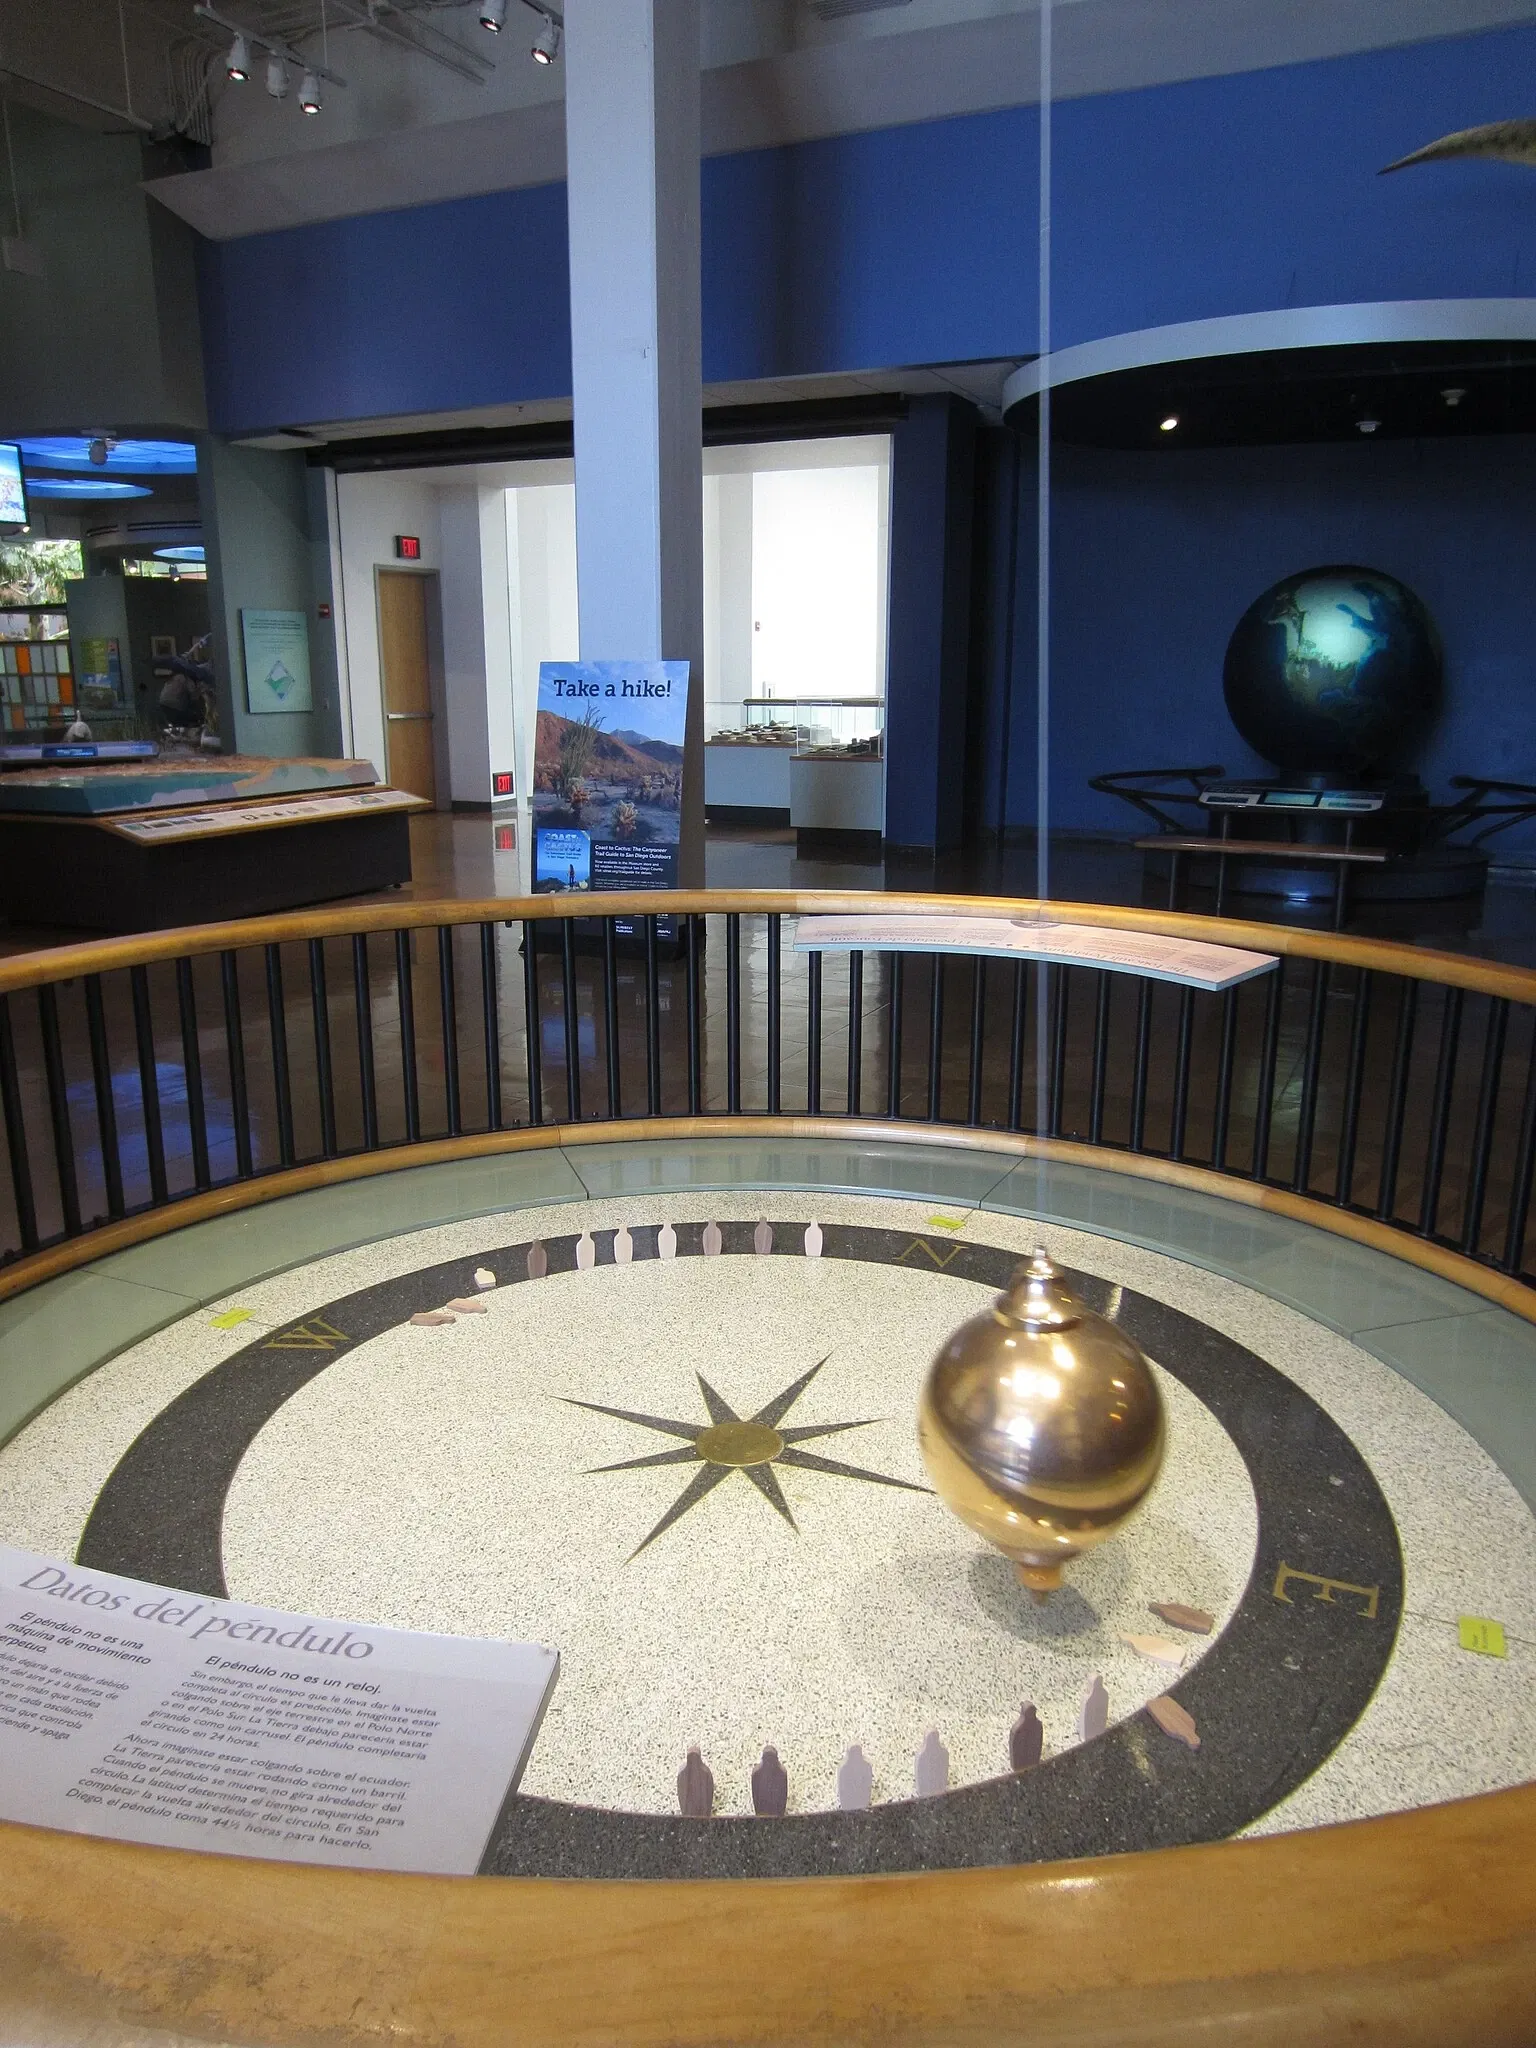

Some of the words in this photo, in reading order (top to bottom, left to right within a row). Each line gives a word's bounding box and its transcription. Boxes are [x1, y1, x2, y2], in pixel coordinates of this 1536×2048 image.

[402, 539, 417, 556] EXIT
[553, 679, 600, 697] Take
[605, 684, 616, 697] a
[621, 679, 671, 698] hike!
[892, 1239, 969, 1268] N
[261, 1315, 350, 1350] W
[1273, 1559, 1379, 1619] E
[19, 1566, 131, 1611] Datos
[133, 1598, 204, 1628] del
[189, 1615, 374, 1660] péndulo
[20, 1611, 36, 1621] El
[30, 1617, 82, 1635] péndulo
[83, 1631, 101, 1640] no
[103, 1635, 119, 1644] es
[120, 1639, 144, 1650] una
[5, 1622, 55, 1642] máquina
[57, 1636, 74, 1647] de
[75, 1641, 152, 1665] movimiento
[26, 1673, 45, 1682] aire
[72, 1684, 104, 1697] fuerza
[105, 1692, 119, 1700] de
[63, 1671, 96, 1682] oscilar
[96, 1678, 129, 1691] debido
[190, 1670, 207, 1679] Sin
[209, 1675, 253, 1689] embargo,
[269, 1686, 305, 1698] tiempo
[308, 1692, 327, 1701] que
[331, 1695, 341, 1703] le
[344, 1697, 367, 1707] lleva
[370, 1701, 389, 1710] dar
[391, 1703, 401, 1712] la
[404, 1705, 437, 1717] vuelta
[205, 1656, 222, 1665] El
[219, 1660, 277, 1677] péndulo
[280, 1671, 300, 1680] no
[303, 1676, 320, 1684] es
[323, 1678, 341, 1687] un
[345, 1681, 382, 1695] reloj.
[18, 1709, 38, 1719] que
[39, 1714, 83, 1730] controla
[19, 1696, 42, 1707] cada
[50, 1692, 70, 1701] que
[71, 1697, 101, 1708] rodea
[171, 1690, 218, 1705] colgando
[219, 1699, 251, 1710] sobre
[253, 1705, 265, 1713] el
[265, 1707, 282, 1717] eje
[285, 1710, 334, 1724] terrestre
[337, 1719, 351, 1727] en
[354, 1721, 365, 1729] el
[367, 1723, 393, 1733] Polo
[396, 1726, 433, 1738] Norte
[181, 1681, 228, 1695] completa
[293, 1702, 352, 1717] predecible.
[411, 1718, 440, 1728] estar
[40, 1728, 70, 1740] apaga
[140, 1719, 151, 1727] el
[192, 1730, 207, 1738] en
[209, 1731, 225, 1742] 24
[226, 1735, 260, 1748] horas.
[148, 1709, 191, 1723] girando
[193, 1718, 225, 1729] como
[227, 1724, 242, 1732] un
[244, 1728, 291, 1741] carrusel.
[294, 1734, 305, 1742] El
[306, 1738, 354, 1751] péndulo
[187, 1704, 200, 1712] el
[200, 1706, 225, 1717] Polo
[248, 1715, 261, 1724] La
[266, 1717, 299, 1731] Tierra
[302, 1723, 340, 1738] debajo
[399, 1740, 429, 1750] estar
[113, 1744, 126, 1753] La
[131, 1746, 164, 1761] Tierra
[223, 1766, 256, 1777] estar
[257, 1772, 309, 1787] rodando
[312, 1781, 348, 1793] como
[351, 1786, 367, 1795] un
[369, 1788, 407, 1801] barril.
[123, 1733, 160, 1747] Ahora
[217, 1753, 248, 1764] estar
[250, 1758, 303, 1774] colgando
[306, 1767, 341, 1780] sobre
[344, 1772, 356, 1781] el
[359, 1775, 410, 1789] ecuador.
[103, 1754, 146, 1771] Cuando
[148, 1765, 160, 1773] el
[160, 1768, 209, 1782] péndulo
[211, 1777, 225, 1786] se
[271, 1788, 288, 1797] no
[289, 1791, 314, 1803] gira
[316, 1795, 378, 1810] alrededor
[381, 1802, 402, 1813] del
[131, 1774, 146, 1784] La
[148, 1777, 186, 1792] latitud
[187, 1785, 248, 1804] determina
[251, 1796, 262, 1807] el
[264, 1800, 308, 1815] tiempo
[311, 1807, 374, 1822] requerido
[376, 1816, 405, 1827] para
[78, 1778, 140, 1797] completar
[141, 1790, 152, 1800] la
[156, 1795, 193, 1808] vuelta
[195, 1801, 261, 1818] alrededor
[261, 1812, 282, 1823] del
[335, 1823, 352, 1833] En
[356, 1825, 379, 1837] San
[106, 1798, 118, 1806] el
[119, 1802, 172, 1817] péndulo
[174, 1812, 208, 1824] toma
[244, 1822, 281, 1837] horas
[284, 1830, 315, 1842] para
[319, 1835, 373, 1850] hacerlo.
